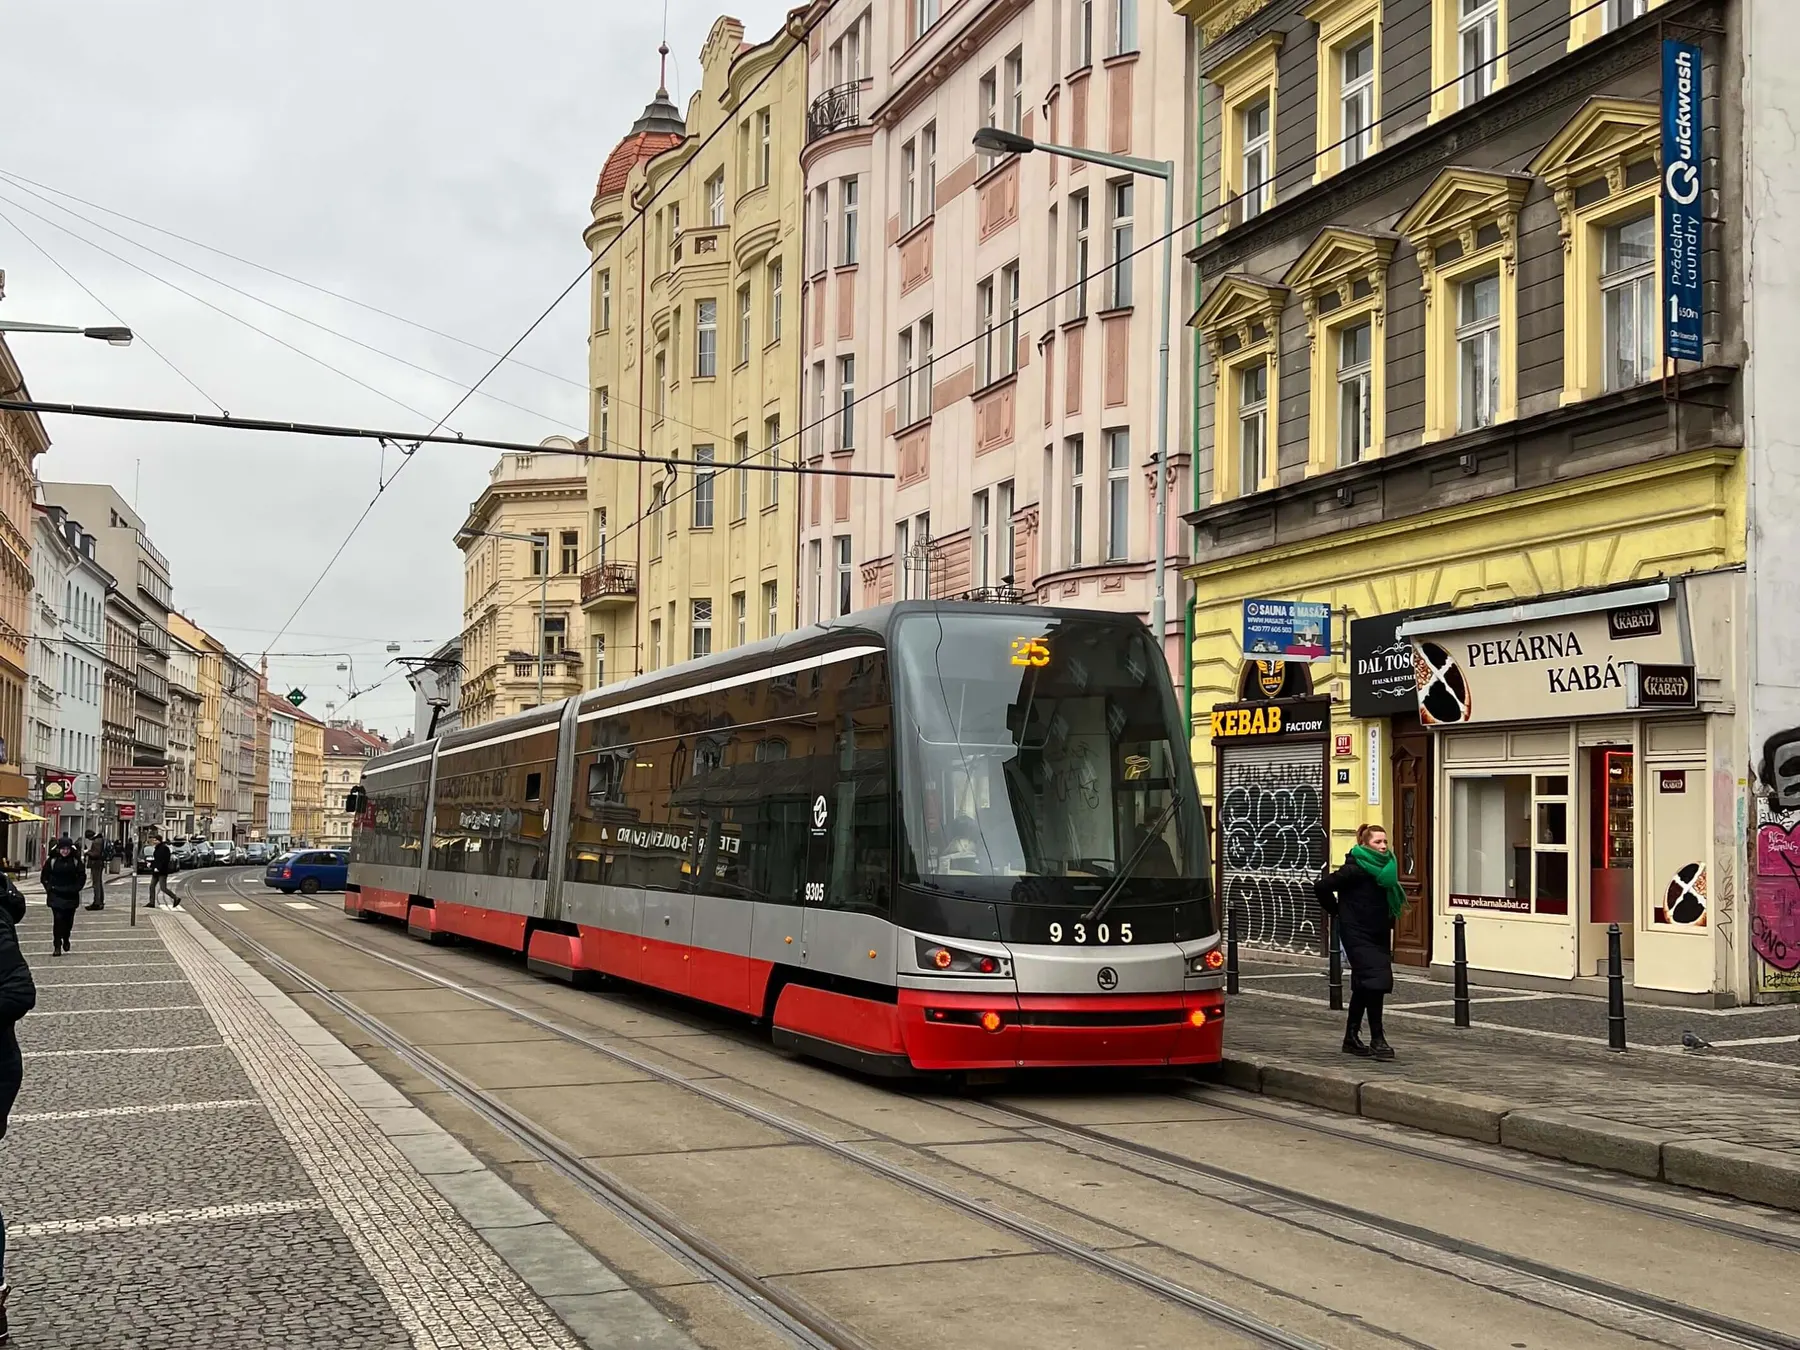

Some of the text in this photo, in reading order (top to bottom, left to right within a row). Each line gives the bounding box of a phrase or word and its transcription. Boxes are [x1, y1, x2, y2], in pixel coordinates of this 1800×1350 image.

[1666, 51, 1699, 204] Quickwash
[1670, 213, 1683, 285] Prádelna
[1685, 216, 1700, 289] Laundry
[1260, 605, 1287, 616] SAUNA
[1289, 605, 1296, 617] &
[1011, 632, 1050, 666] 25
[1467, 631, 1583, 668] PEKÁRNA
[1358, 657, 1383, 675] DAL
[1210, 706, 1323, 737] KEBAB FACTORY
[1339, 771, 1347, 781] 73
[805, 882, 824, 901] 9305
[1049, 922, 1133, 943] 9305
